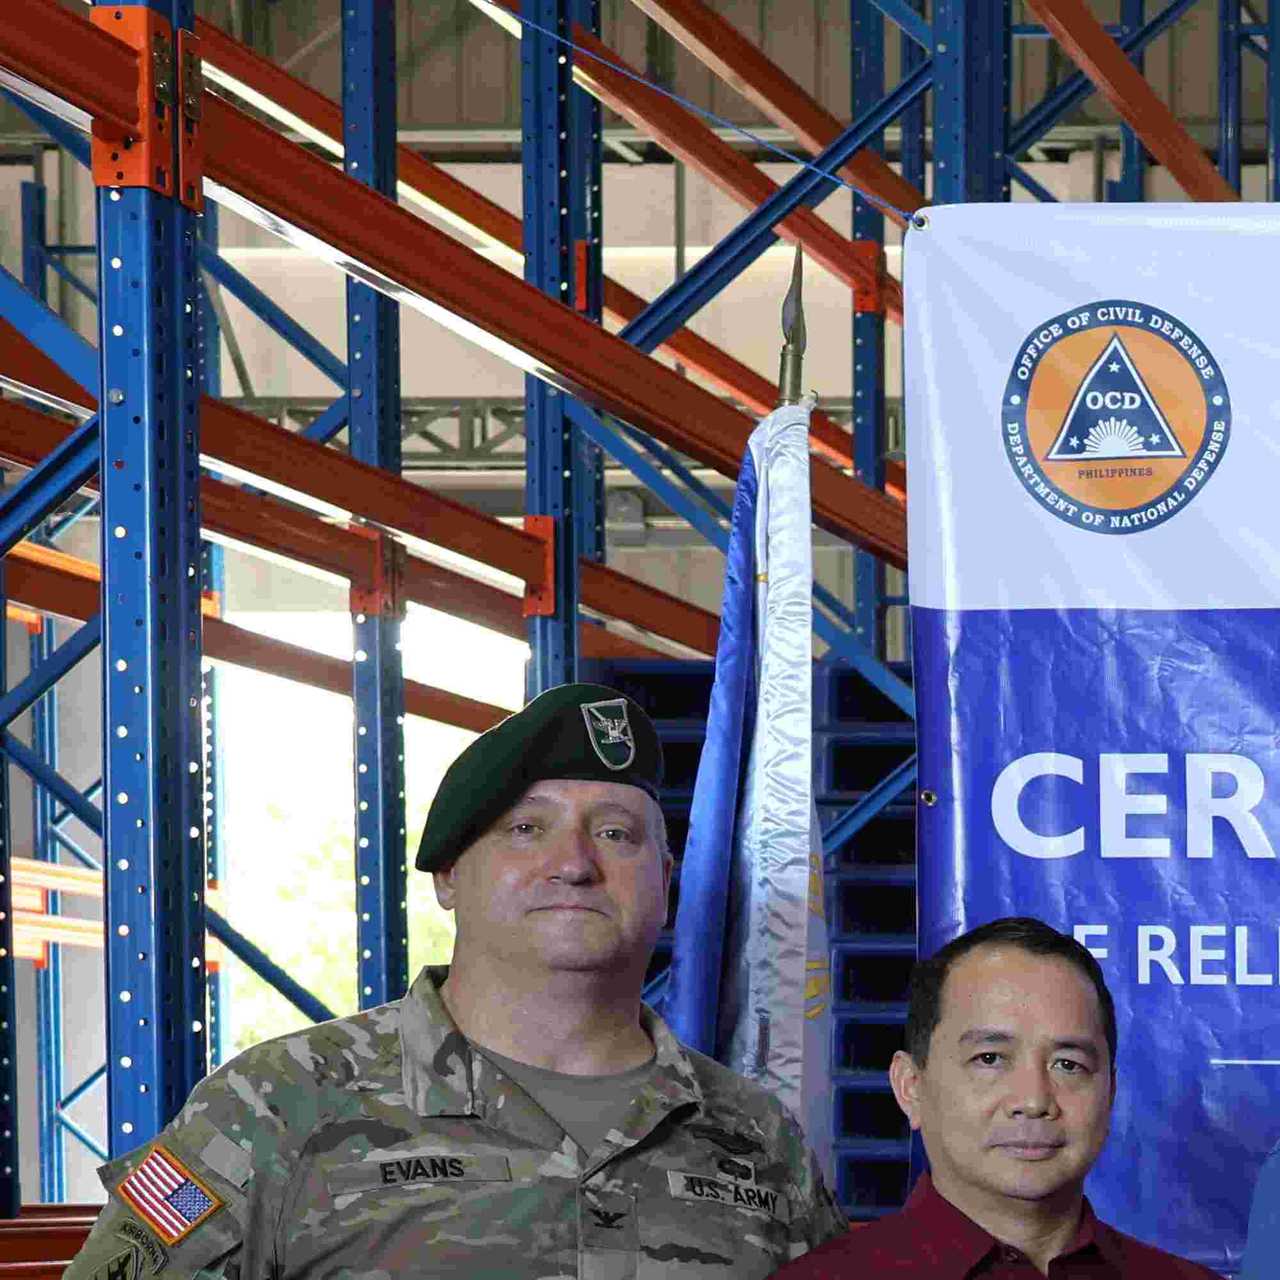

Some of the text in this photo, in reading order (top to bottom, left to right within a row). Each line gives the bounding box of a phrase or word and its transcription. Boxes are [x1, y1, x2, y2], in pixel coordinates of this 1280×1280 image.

[1017, 307, 1215, 380] OFFICE OF CIVIL DEFENSE
[1085, 391, 1142, 410] OCD
[1007, 420, 1225, 528] DEPARTMENT OF NATIONAL DEFENSE
[1078, 467, 1153, 479] PHILIPPINES
[380, 1156, 465, 1184] EVANS
[685, 1175, 779, 1213] U.S. ARMY
